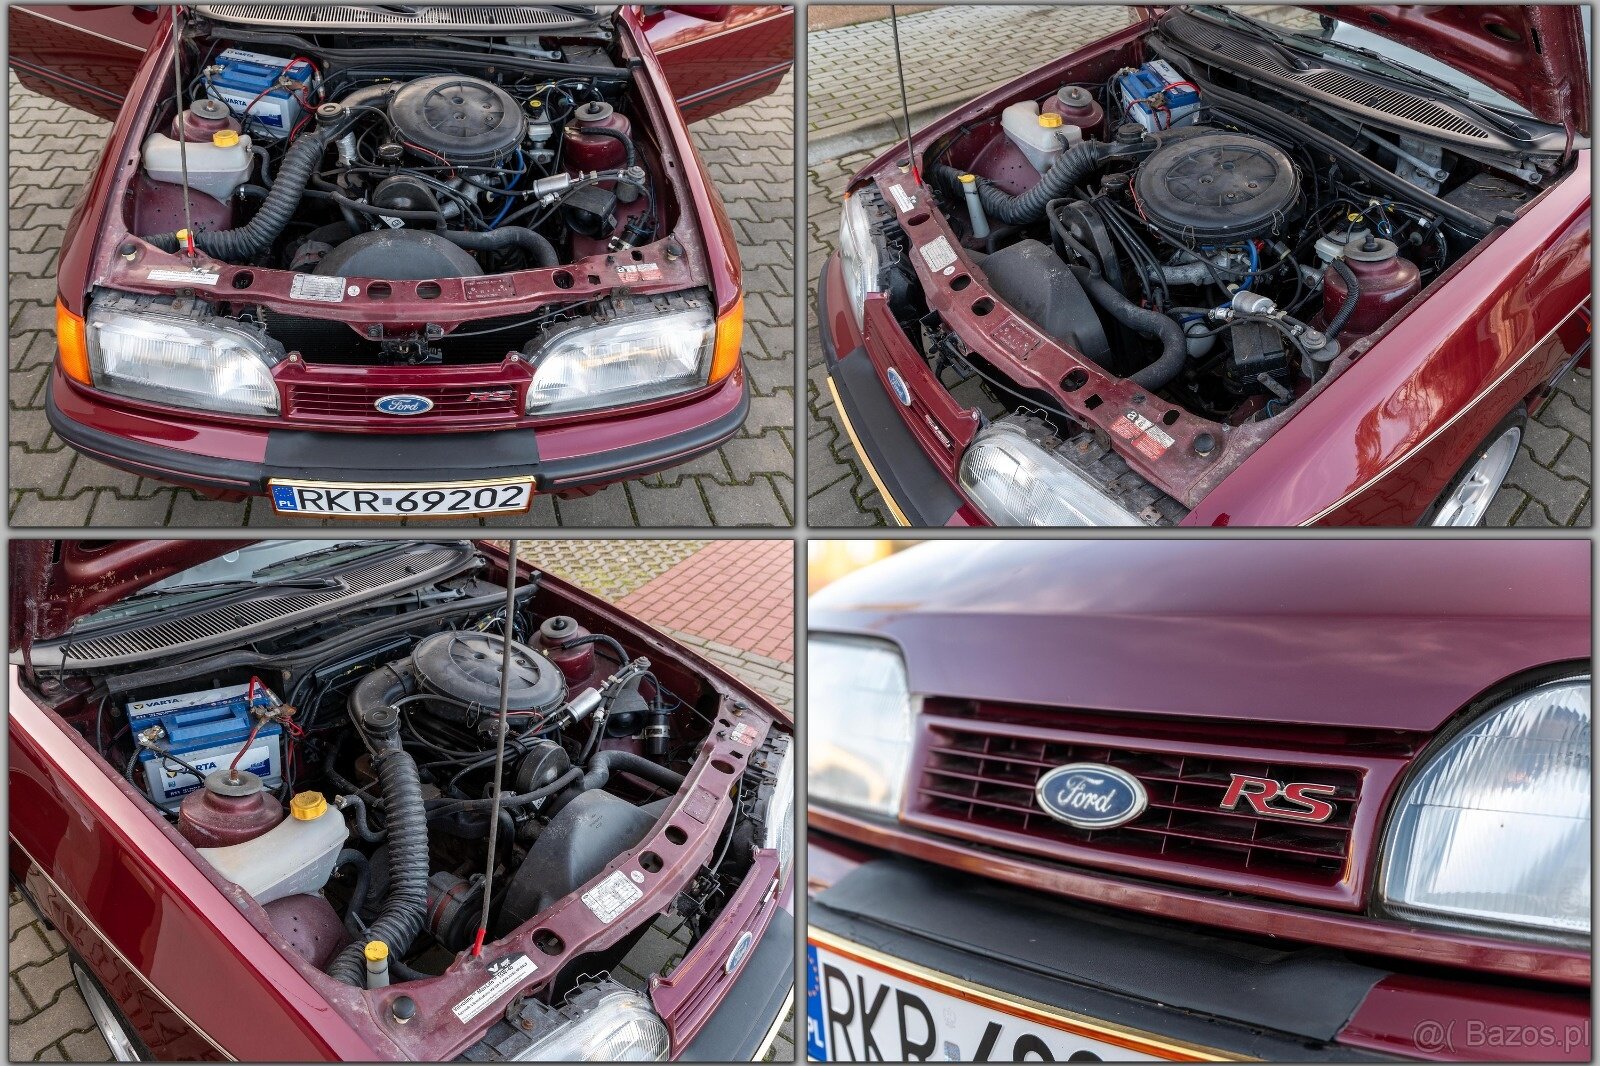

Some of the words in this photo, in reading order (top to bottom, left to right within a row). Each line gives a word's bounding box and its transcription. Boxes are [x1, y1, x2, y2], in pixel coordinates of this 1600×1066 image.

[388, 399, 419, 411] Ford
[279, 500, 295, 508] PL
[297, 488, 380, 513] RKR
[395, 485, 524, 513] 69202
[145, 698, 180, 708] VARTA
[1057, 775, 1116, 814] Ford
[1220, 773, 1338, 822] RS
